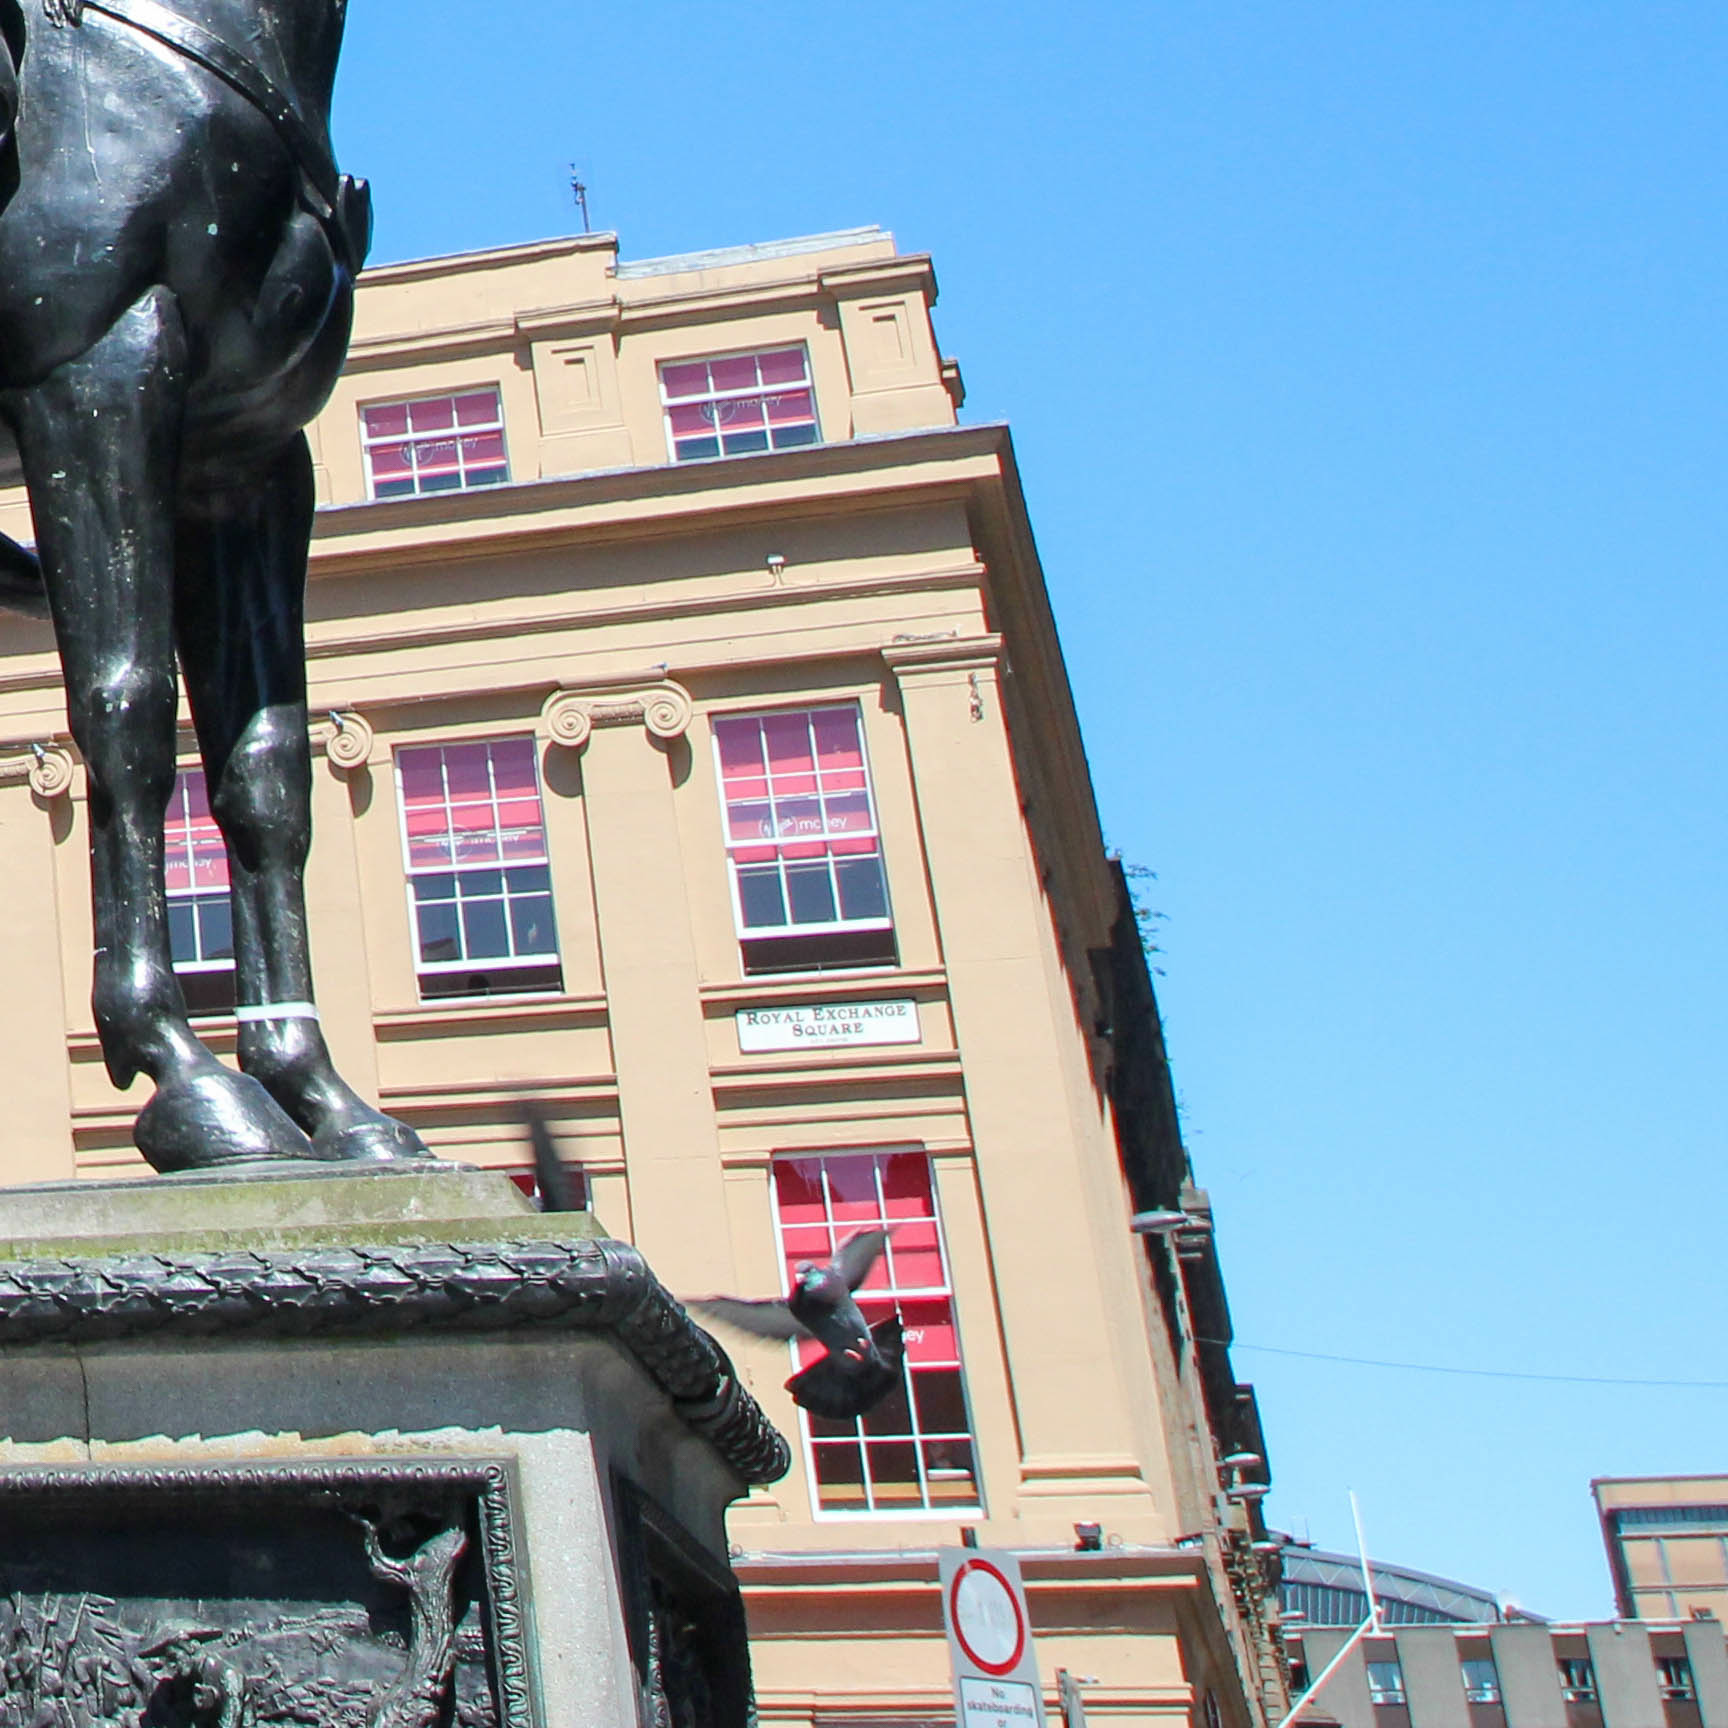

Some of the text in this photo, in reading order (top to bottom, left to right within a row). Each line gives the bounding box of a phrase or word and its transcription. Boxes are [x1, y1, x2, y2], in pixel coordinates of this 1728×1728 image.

[746, 1004, 908, 1026] ROYAL EXCHANGE
[792, 1022, 864, 1038] SQUARE
[990, 1686, 1006, 1699] No
